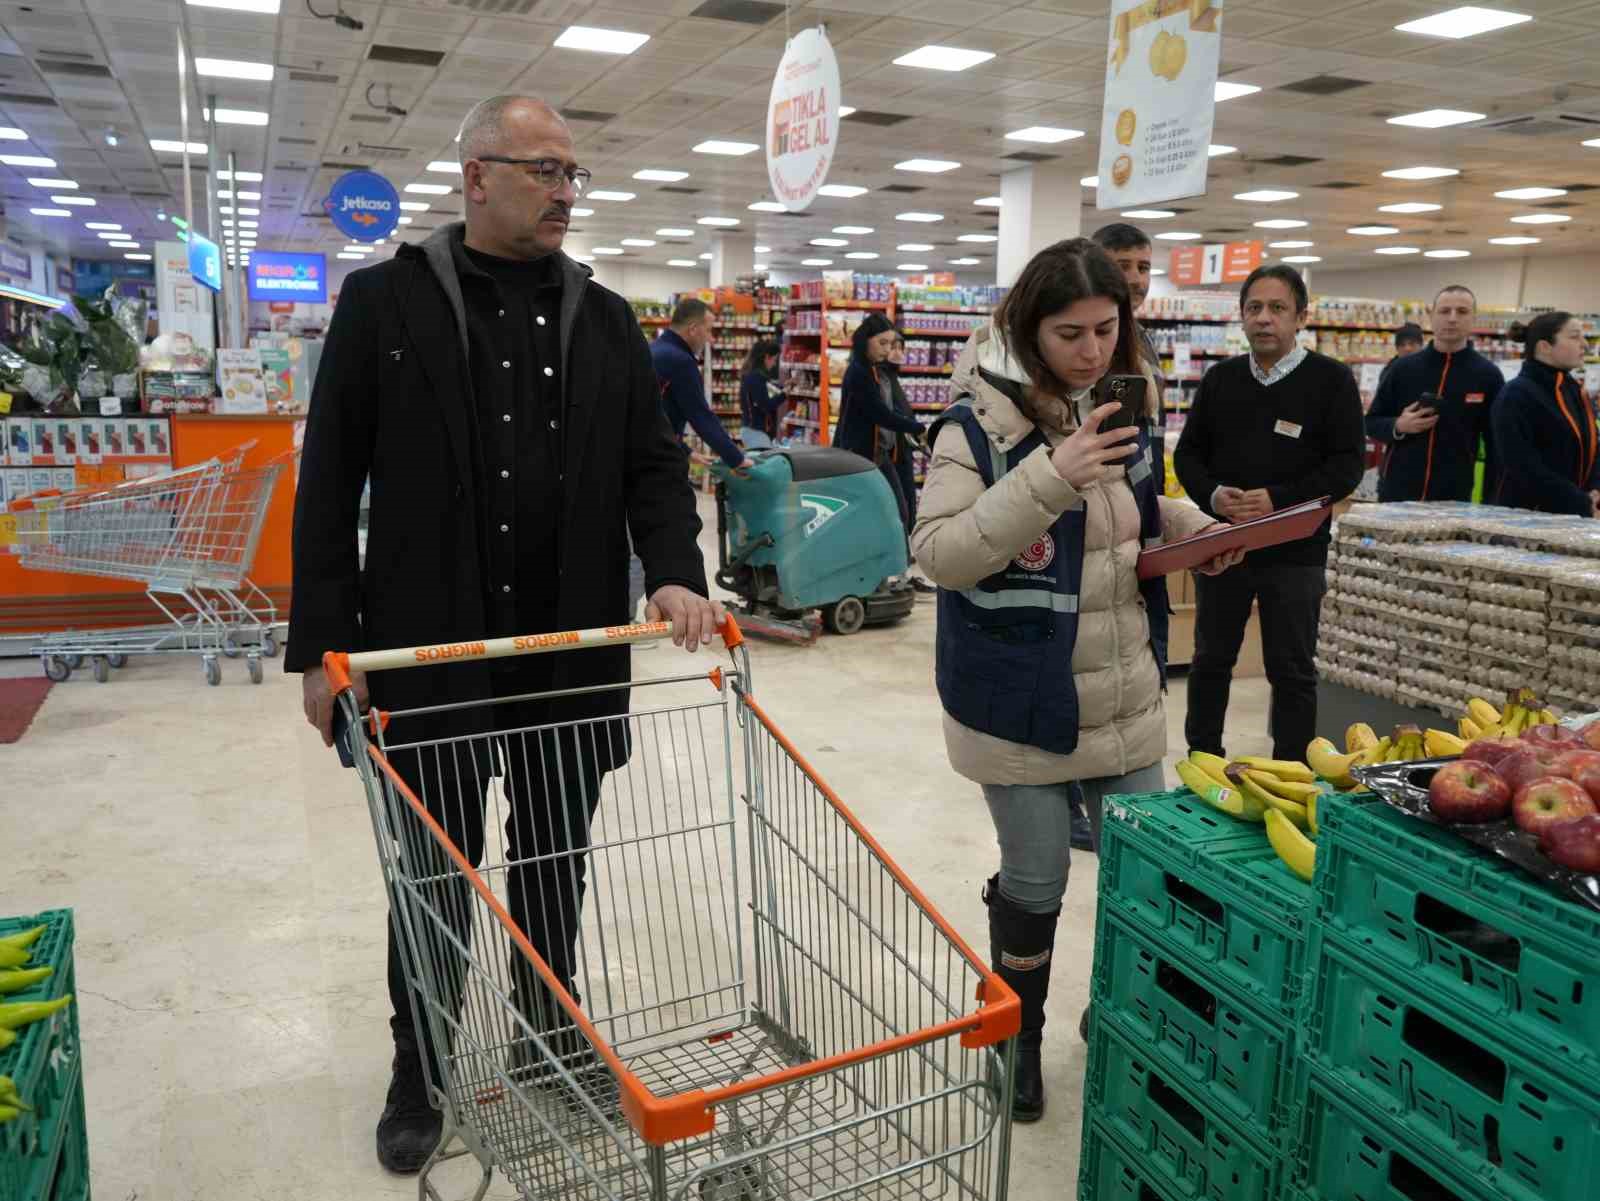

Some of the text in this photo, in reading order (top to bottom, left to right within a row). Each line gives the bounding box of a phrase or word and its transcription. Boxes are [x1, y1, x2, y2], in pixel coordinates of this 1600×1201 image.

[791, 117, 830, 153] GEL AL
[1208, 253, 1218, 275] 1
[414, 640, 486, 662] MIGROS
[513, 630, 580, 651] MIGROS
